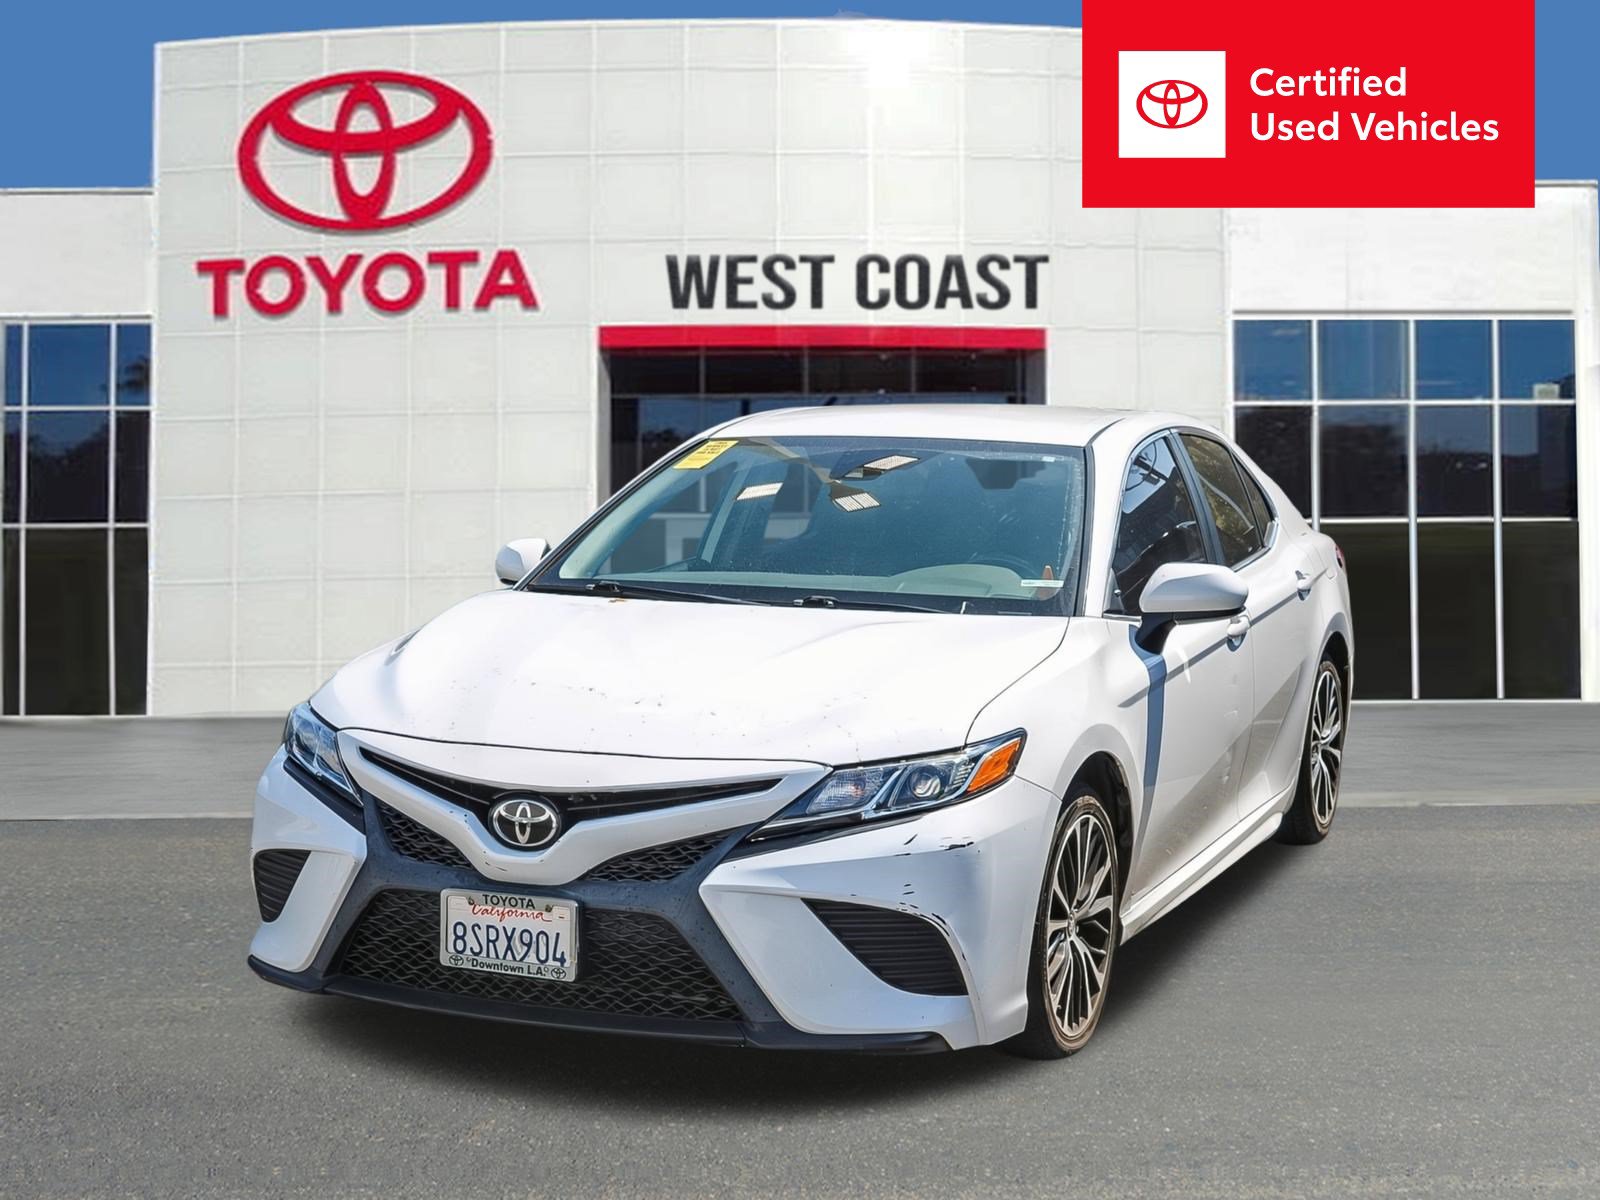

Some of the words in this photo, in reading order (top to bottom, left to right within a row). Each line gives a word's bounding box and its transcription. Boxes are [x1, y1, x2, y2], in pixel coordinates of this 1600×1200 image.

[195, 249, 539, 319] TOYOTA
[666, 254, 835, 310] WEST
[856, 254, 1049, 310] COAST
[471, 904, 552, 922] California
[482, 893, 536, 910] TOYOTA
[452, 921, 567, 967] 8SRX904
[471, 959, 525, 975] Downtown
[526, 964, 546, 977] L.A.
